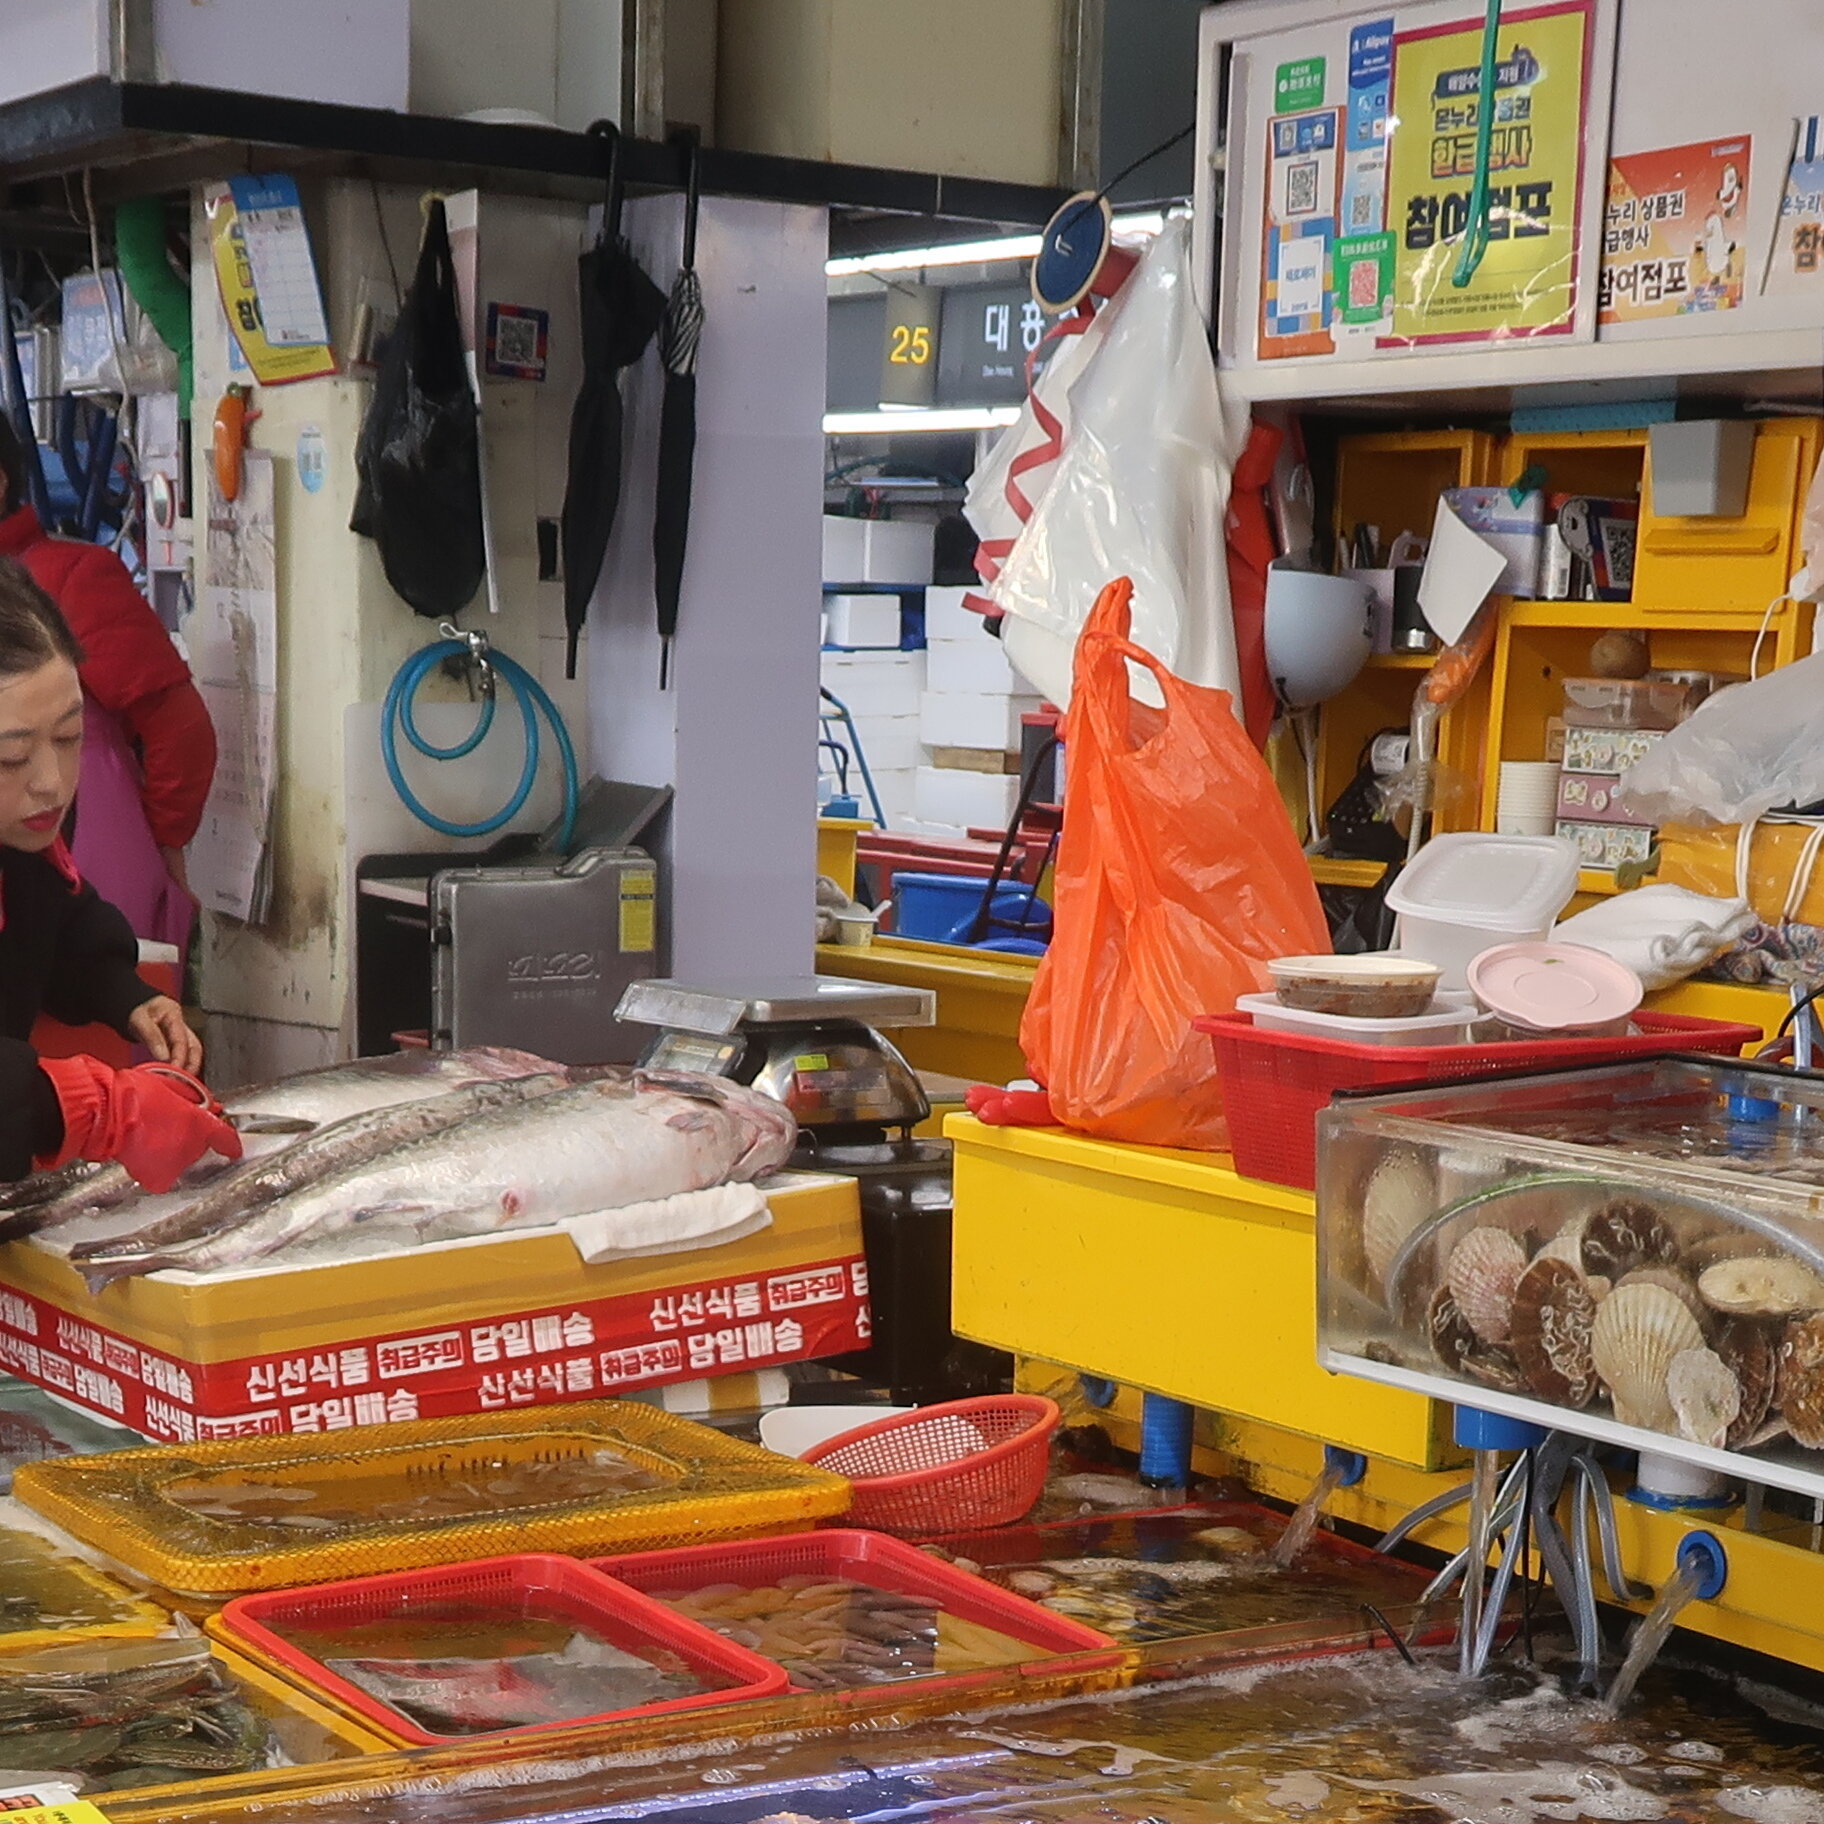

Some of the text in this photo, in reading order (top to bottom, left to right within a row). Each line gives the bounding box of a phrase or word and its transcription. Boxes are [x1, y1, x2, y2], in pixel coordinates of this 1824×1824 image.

[1606, 225, 1651, 254] 급행사
[889, 324, 931, 365] 25
[648, 1281, 762, 1332] 신선식품
[246, 1346, 371, 1403] 신선식품
[471, 1310, 596, 1364] 당일배송
[686, 1317, 805, 1370] 당일배송
[288, 1386, 420, 1434] 당일배송
